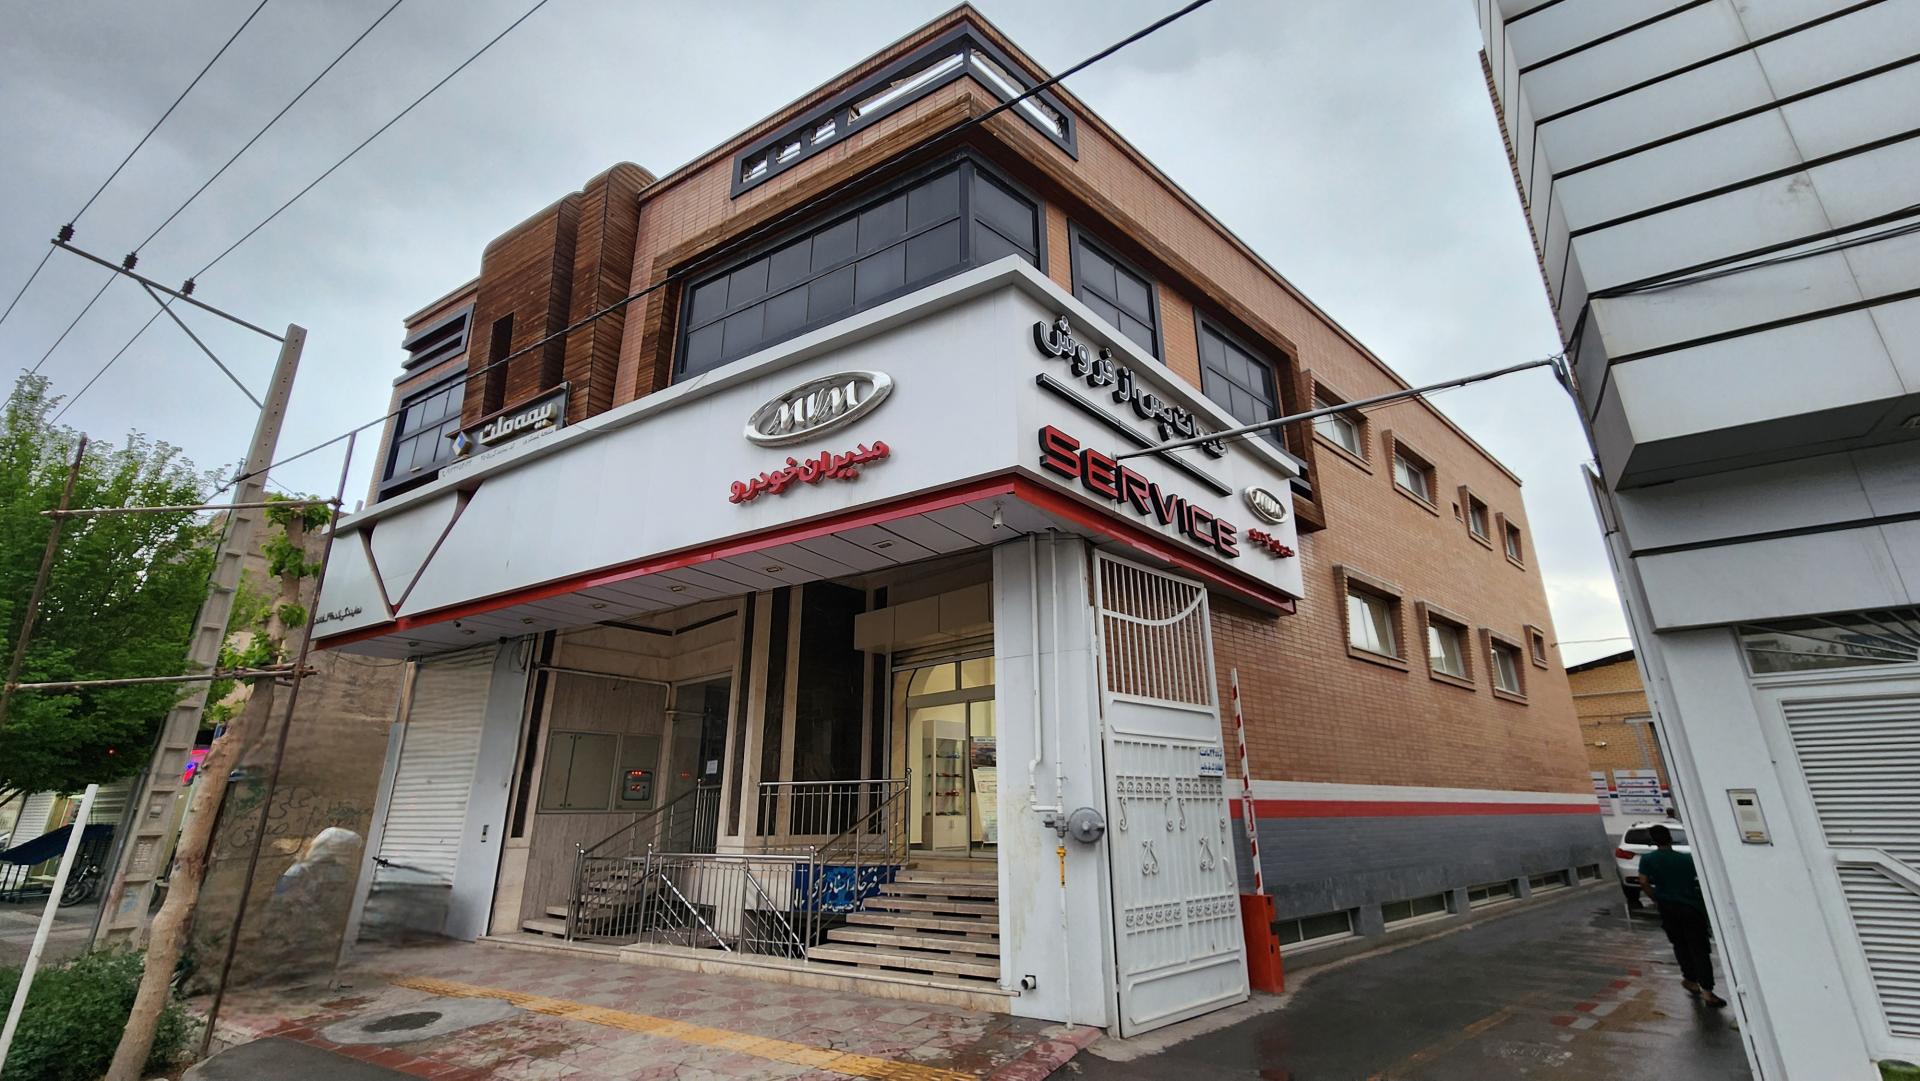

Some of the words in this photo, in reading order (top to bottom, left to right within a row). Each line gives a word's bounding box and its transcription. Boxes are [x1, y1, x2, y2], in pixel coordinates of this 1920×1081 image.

[1033, 314, 1117, 388] فروش
[766, 379, 861, 436] MVM
[1113, 366, 1138, 404] از
[478, 415, 515, 446] ملت
[514, 402, 557, 430] بیمه
[1133, 391, 1174, 442] پس
[728, 456, 799, 504] خودرو
[798, 440, 892, 484] مدیران
[1038, 424, 1240, 558] SERVICE
